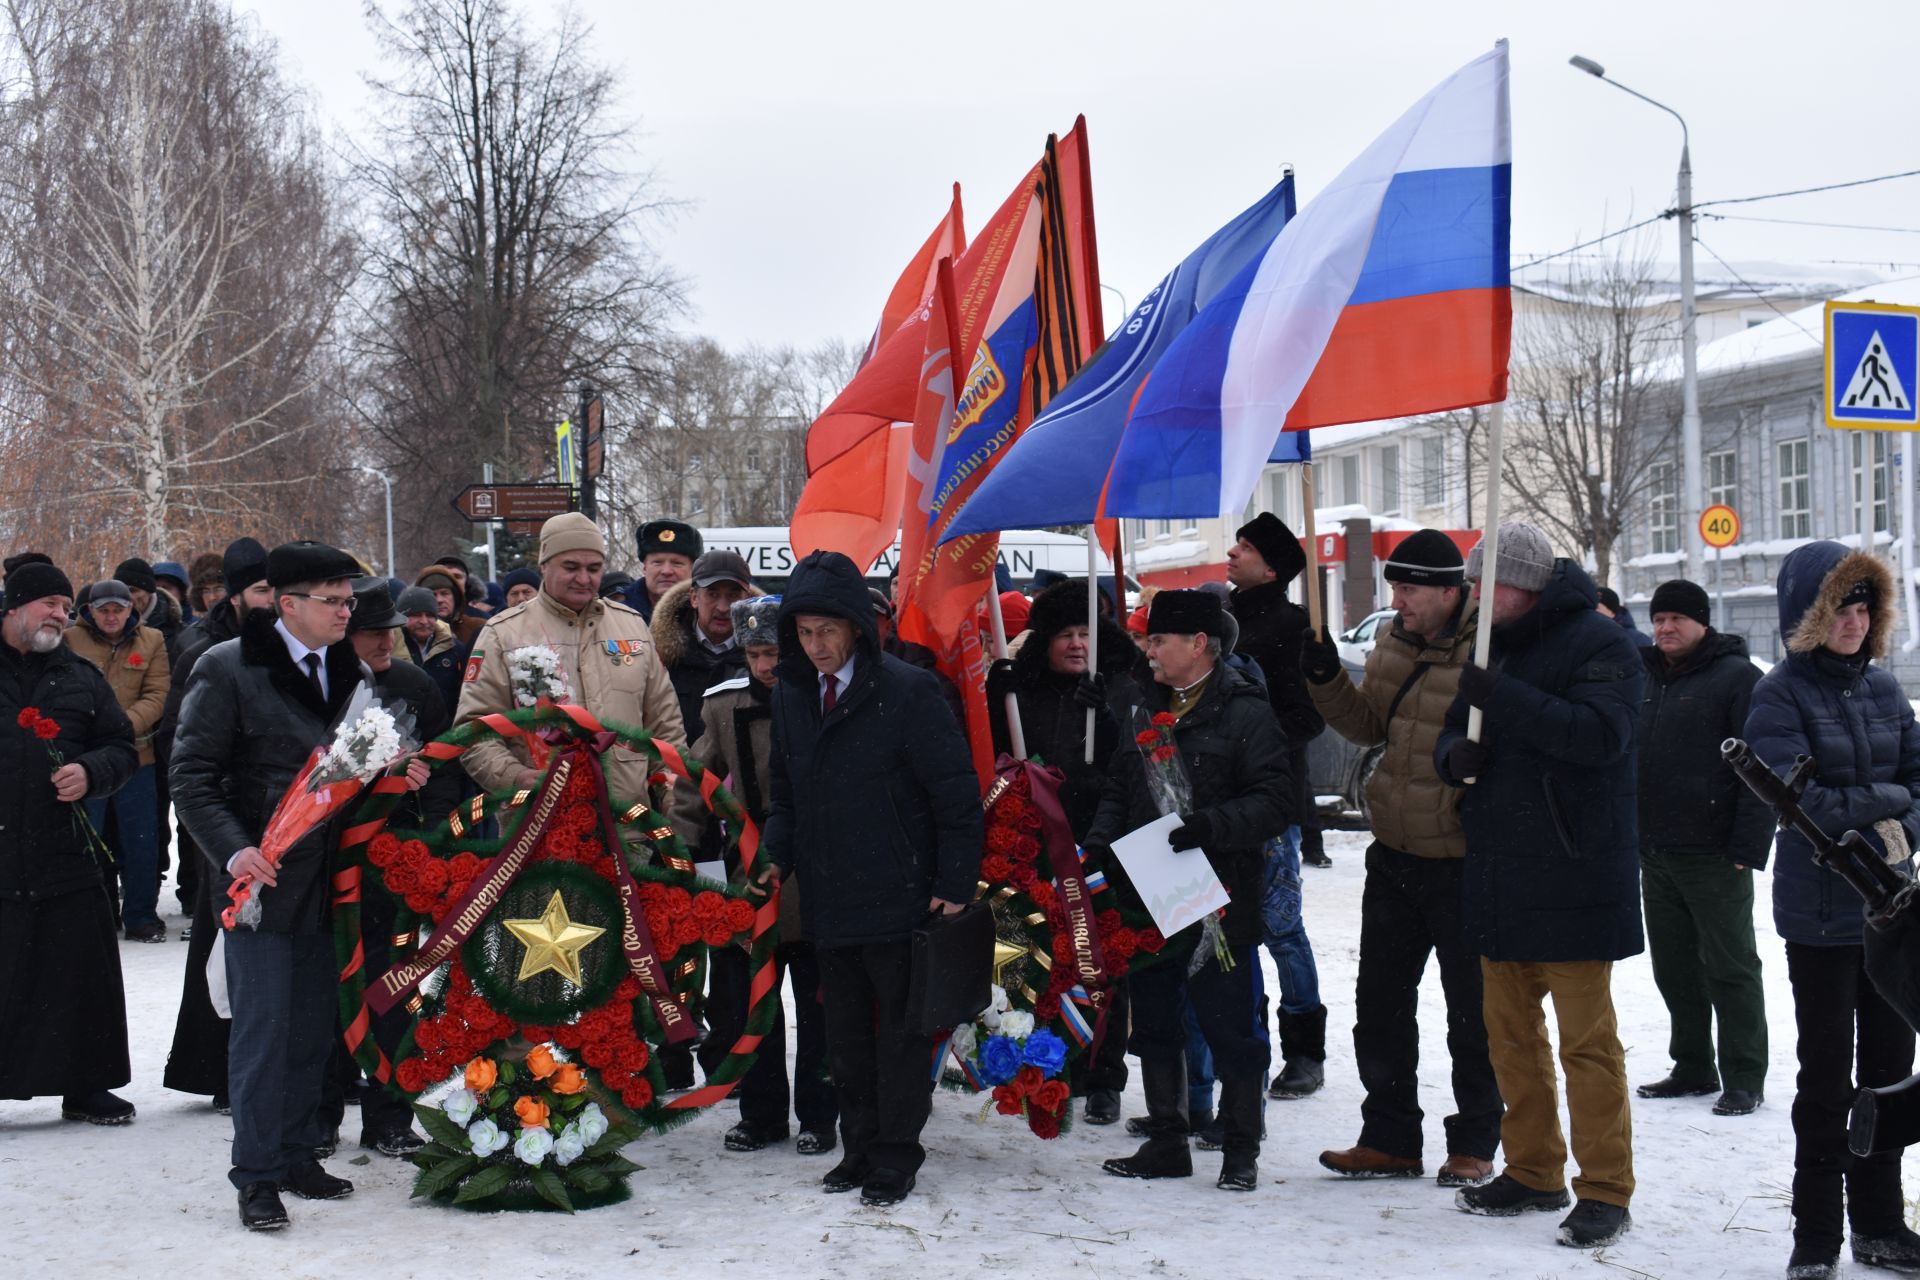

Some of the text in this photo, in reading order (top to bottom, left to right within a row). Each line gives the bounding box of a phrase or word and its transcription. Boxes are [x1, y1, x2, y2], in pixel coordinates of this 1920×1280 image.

[1708, 518, 1731, 535] 40
[453, 760, 571, 936] интернационалистам
[1063, 877, 1082, 903] от
